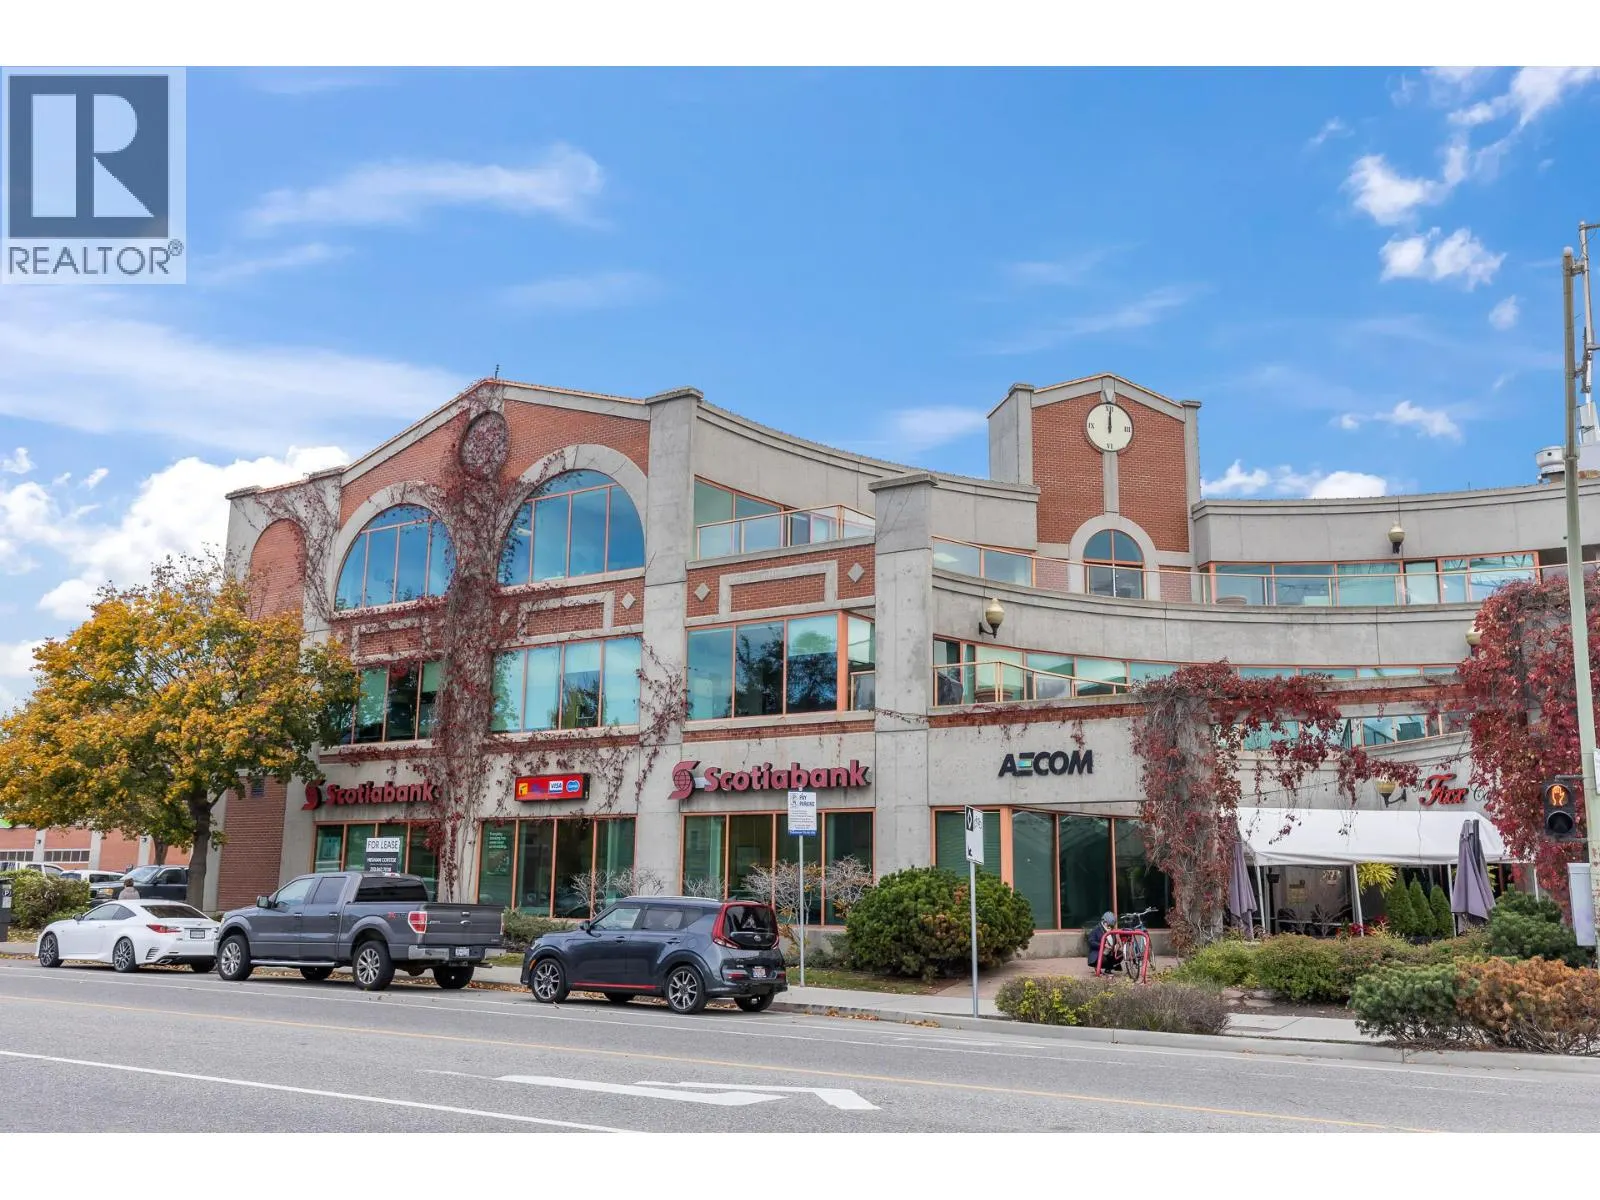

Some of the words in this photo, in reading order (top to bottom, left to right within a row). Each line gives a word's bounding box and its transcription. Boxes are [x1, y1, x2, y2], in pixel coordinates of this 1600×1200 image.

[703, 759, 869, 793] Scotiabank
[998, 750, 1093, 777] AECOM
[325, 780, 435, 807] Scotiabank
[550, 782, 562, 790] VISA
[367, 840, 379, 849] FOR
[380, 840, 398, 850] LEASE
